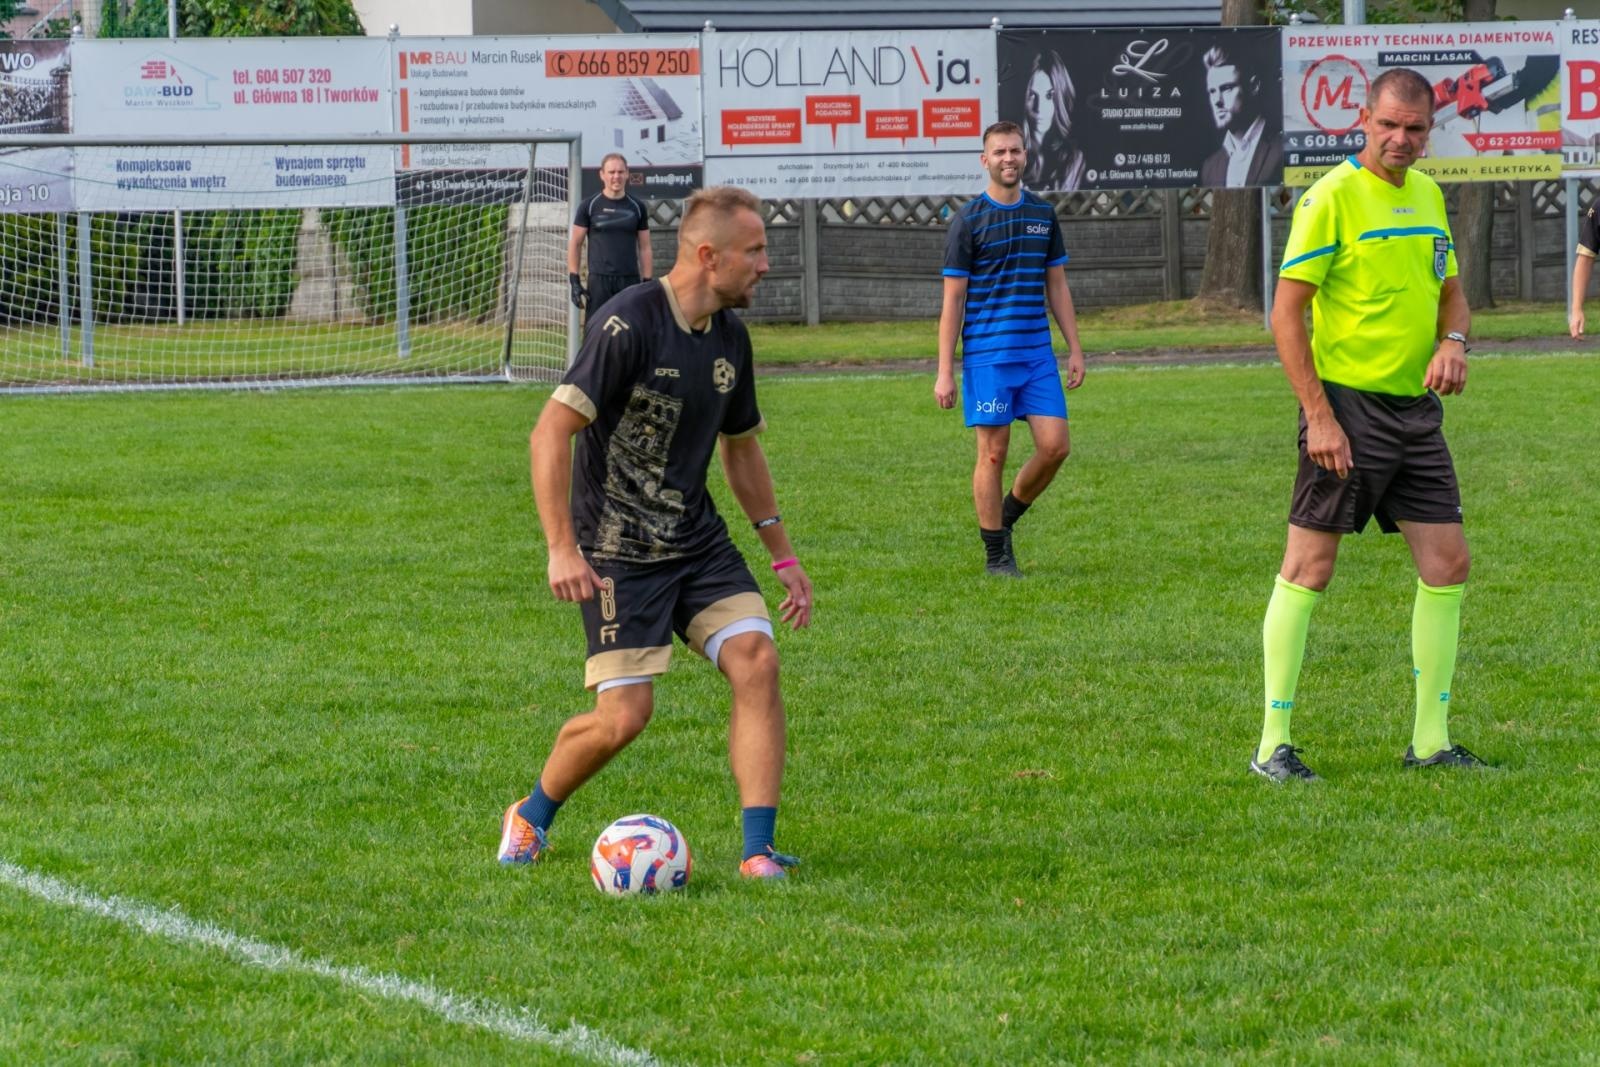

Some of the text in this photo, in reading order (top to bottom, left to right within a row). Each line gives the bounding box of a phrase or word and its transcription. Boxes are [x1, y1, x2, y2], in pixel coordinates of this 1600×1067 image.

[1289, 31, 1554, 48] PRZEWIERTY TECHNIKĄ DIAMENTOWĄ
[1572, 29, 1600, 45] RES
[0, 52, 35, 70] WO
[410, 50, 542, 64] MR BAU Marcin Rusek
[578, 50, 690, 75] 666 859 250
[1384, 52, 1472, 62] MARCIN LASAK
[232, 68, 332, 85] tel. 604 507 320
[233, 90, 249, 104] ul.
[252, 88, 298, 104] Główna
[300, 88, 314, 103] 18
[324, 86, 379, 103] Tworków
[420, 86, 525, 98] kompleksowa budowa domów
[1101, 86, 1181, 98] LUIZA
[420, 102, 459, 110] rozbudowa
[466, 102, 508, 112] przebudowa
[510, 100, 546, 111] budynków
[548, 100, 596, 109] mieszkalnych
[1102, 107, 1182, 118] STUDIO SZTUKI FRYZJERSKIEJ
[420, 115, 450, 126] remonty
[458, 114, 504, 126] wykończenia
[1304, 134, 1369, 148] 608 46
[421, 144, 450, 154] projekty
[274, 156, 366, 172] Wynajem sprzętu
[1127, 154, 1136, 164] 32
[1142, 154, 1154, 164] 419
[1162, 153, 1170, 164] 21
[116, 159, 192, 173] Kompleksowe
[1415, 164, 1552, 176] OD-KAN ELEKTRYKA
[275, 173, 347, 188] budowlanego
[1110, 169, 1134, 180] Główna
[1145, 169, 1168, 178] 47-451
[1168, 168, 1198, 178] Tworków
[116, 174, 226, 192] wykończenia wnętrz
[28, 184, 50, 201] 10
[1026, 222, 1050, 235] safer
[976, 398, 1008, 414] safer
